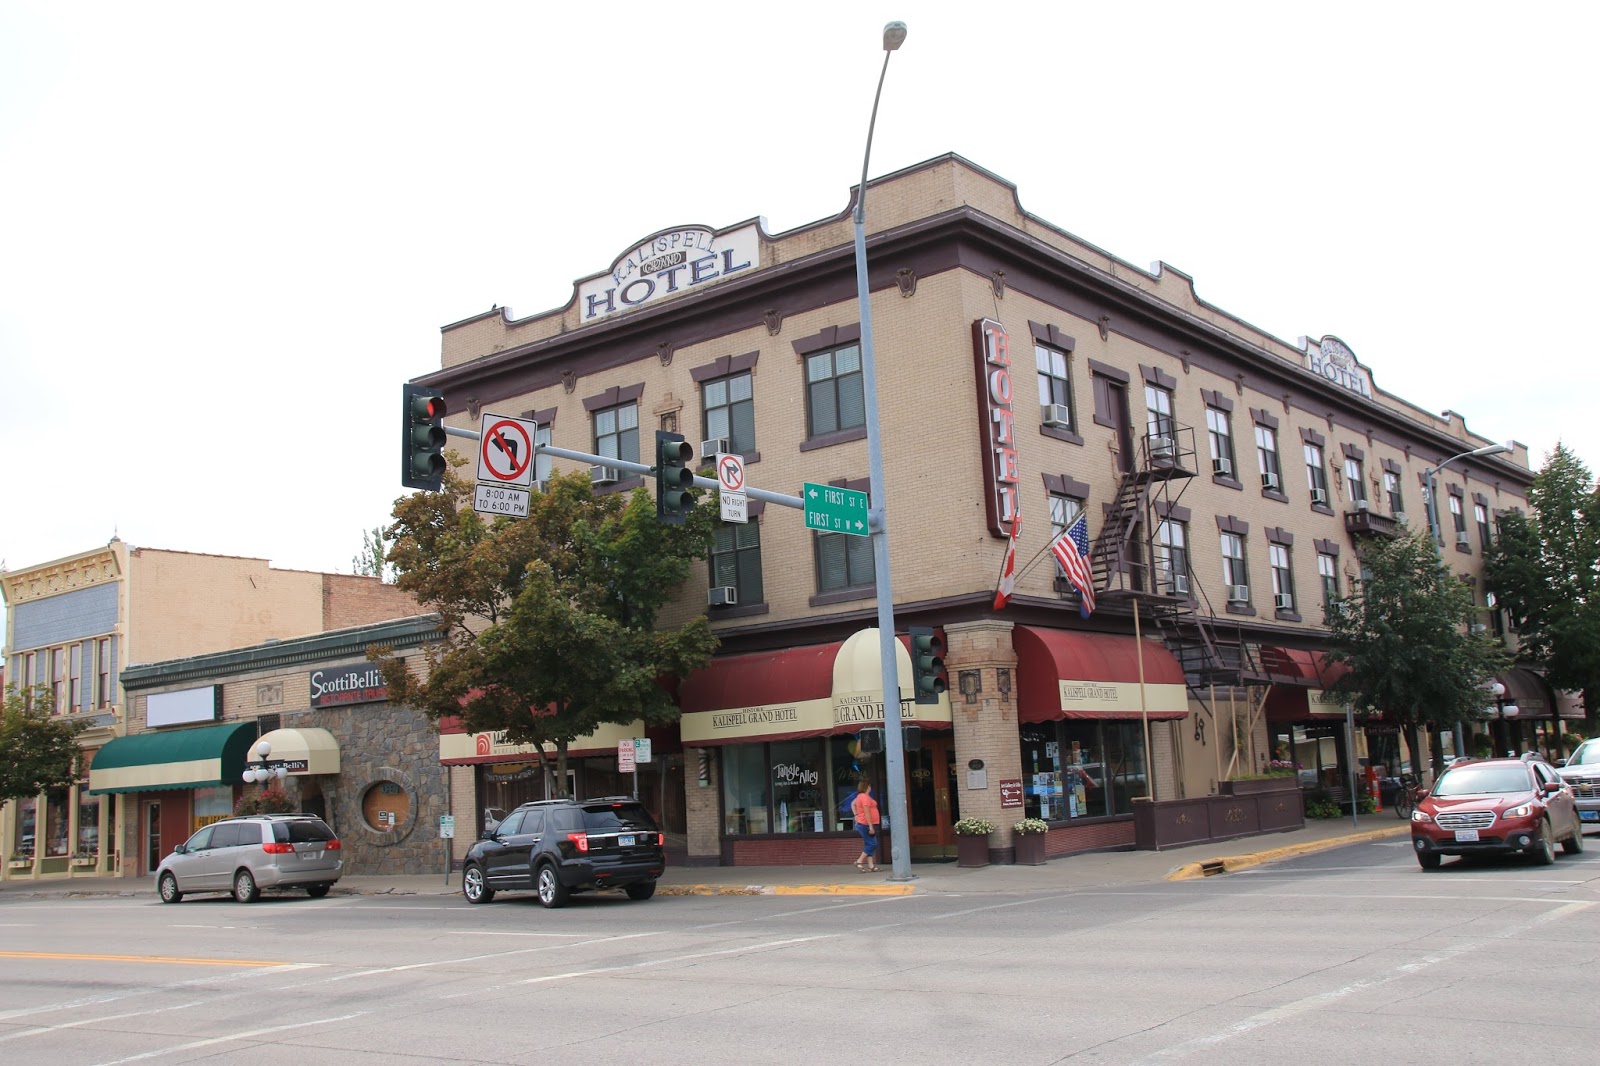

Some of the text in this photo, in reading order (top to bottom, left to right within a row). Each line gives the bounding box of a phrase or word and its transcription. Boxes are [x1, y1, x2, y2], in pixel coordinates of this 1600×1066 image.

[612, 231, 716, 287] KALISPELL
[642, 251, 683, 274] GRAND
[585, 248, 752, 319] HOTEL
[1309, 353, 1373, 399] HOTEL
[984, 328, 1023, 524] HOTEL
[485, 488, 520, 502] 8:00 AM
[722, 496, 745, 507] NO RIGHT
[824, 489, 864, 509] FIRST ST E
[478, 499, 525, 513] TO 6:00 PM
[728, 508, 742, 518] TURN
[809, 511, 851, 530] FIRST ST W
[840, 695, 872, 704] KALISPELL
[712, 708, 798, 727] KALISPELL GRAND HOTEL
[840, 704, 873, 723] GRAND
[876, 702, 914, 719] HEL
[283, 761, 305, 769] Belli's
[773, 763, 800, 781] Tangle
[799, 769, 818, 786] Alley
[199, 816, 210, 824] FOR
